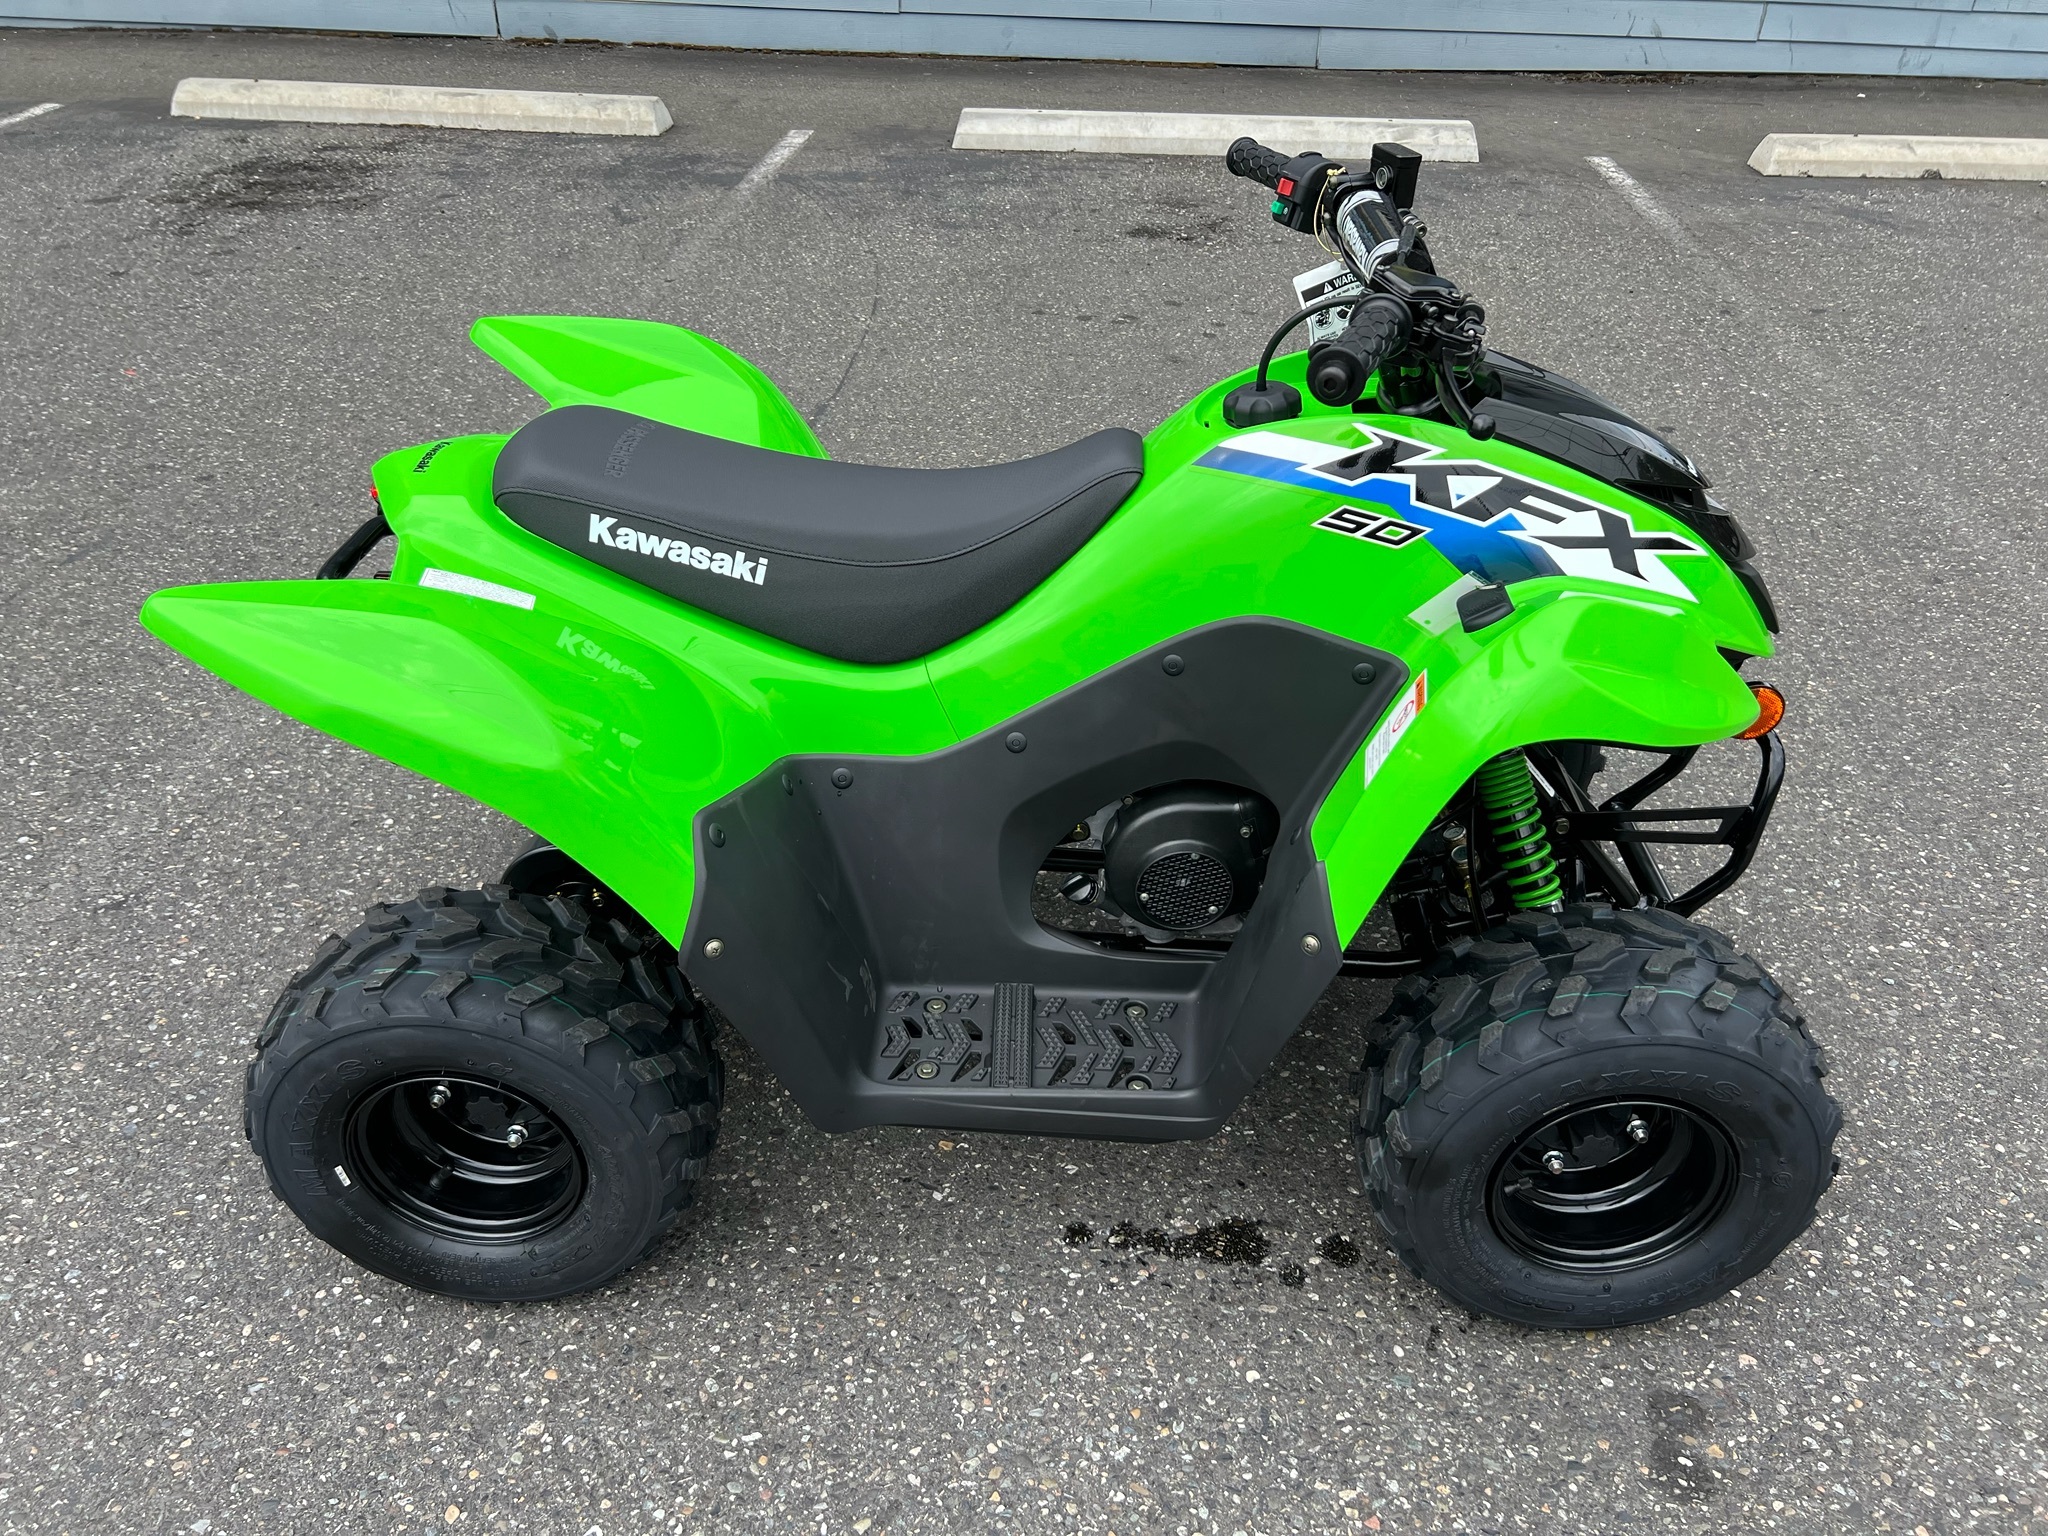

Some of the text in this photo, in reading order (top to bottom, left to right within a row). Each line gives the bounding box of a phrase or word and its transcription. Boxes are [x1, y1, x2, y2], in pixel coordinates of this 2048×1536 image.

[1333, 273, 1357, 288] WAR
[588, 513, 769, 586] Kawasaki
[1314, 505, 1431, 548] 50
[1507, 1069, 1743, 1126] MAXXIS
